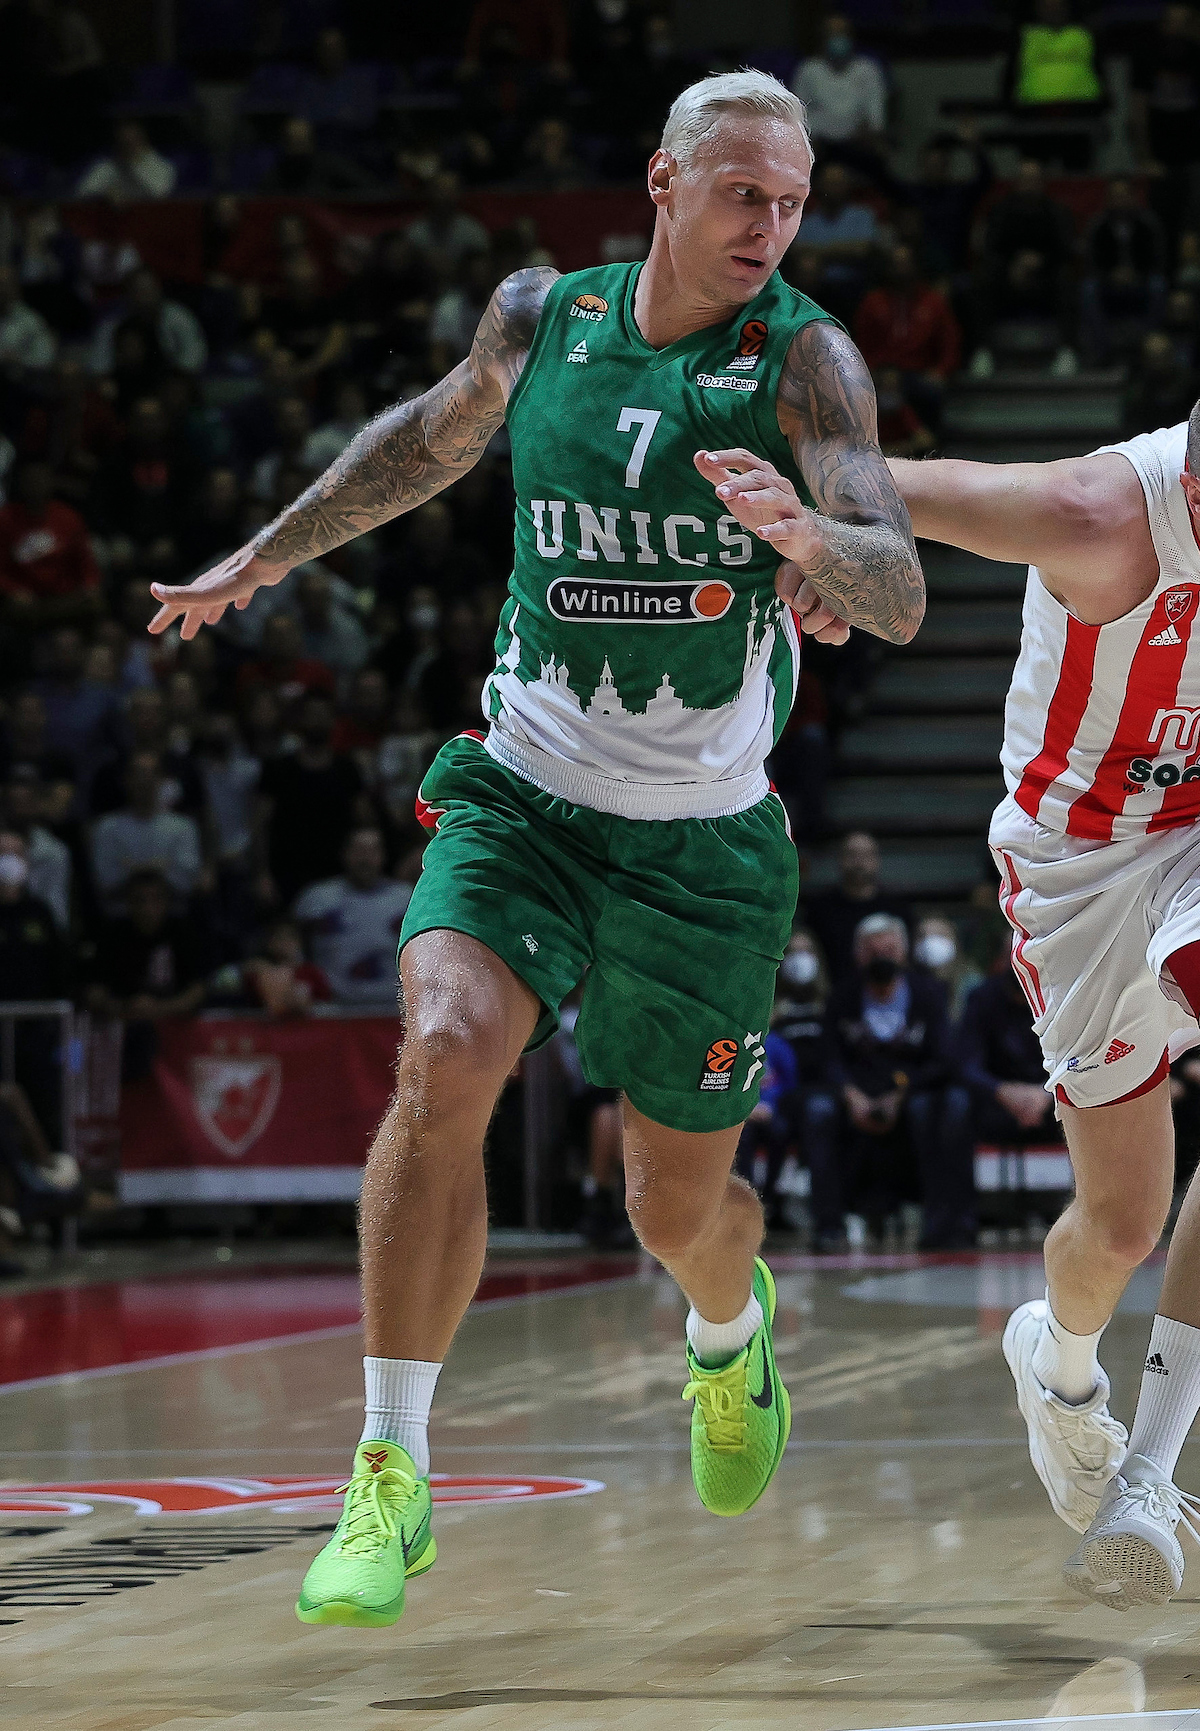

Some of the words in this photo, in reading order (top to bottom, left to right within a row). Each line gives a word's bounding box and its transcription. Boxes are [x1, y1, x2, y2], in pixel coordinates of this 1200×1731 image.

[569, 303, 607, 322] UNICS
[566, 352, 590, 364] PEAK
[616, 406, 663, 488] 7
[530, 499, 752, 567] UNICS
[560, 588, 682, 614] Winline
[1148, 635, 1182, 646] adidas
[1103, 1043, 1136, 1065] adidas
